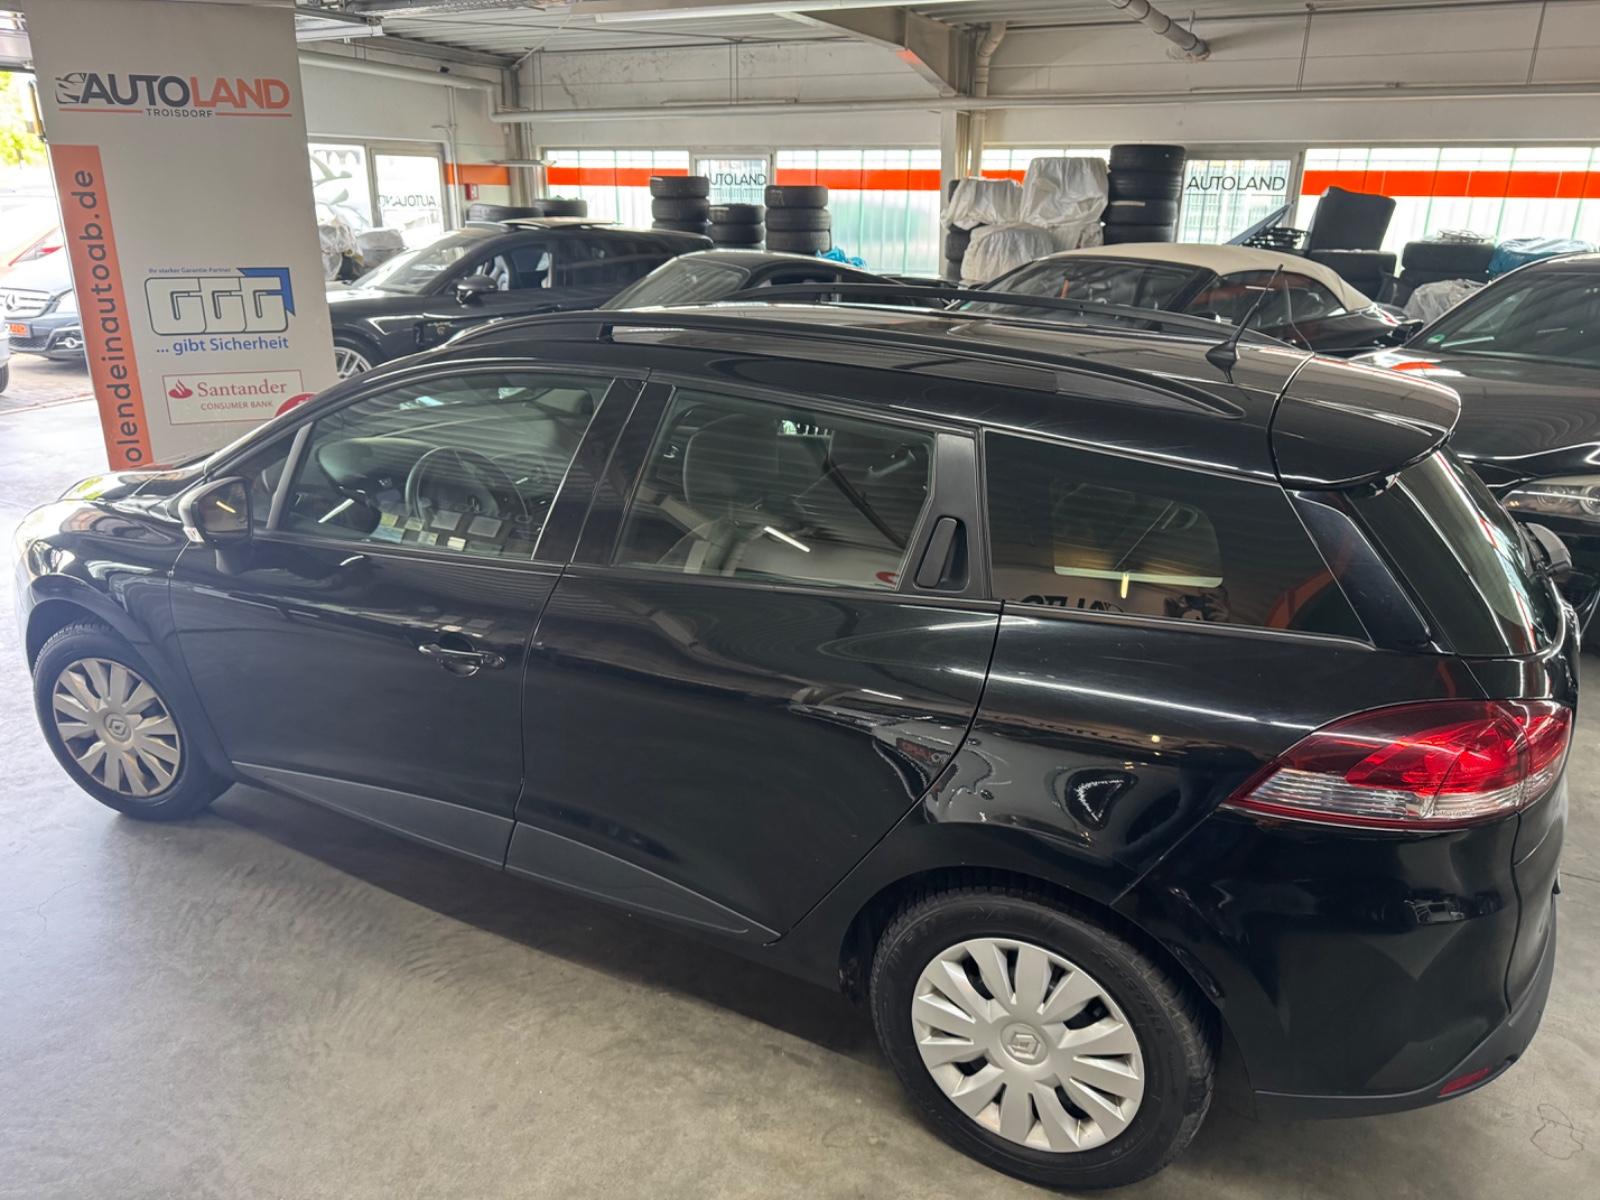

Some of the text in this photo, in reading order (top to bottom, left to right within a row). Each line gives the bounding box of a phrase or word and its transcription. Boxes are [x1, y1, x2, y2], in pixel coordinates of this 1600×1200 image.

[80, 72, 290, 110] AUTOLAND
[145, 108, 213, 118] TROISDORF
[1187, 176, 1286, 191] AUTOLAND
[173, 338, 207, 355] gibt
[209, 336, 289, 351] Sicherheit
[197, 378, 287, 397] Santander
[200, 400, 274, 411] CONSUMER BANK
